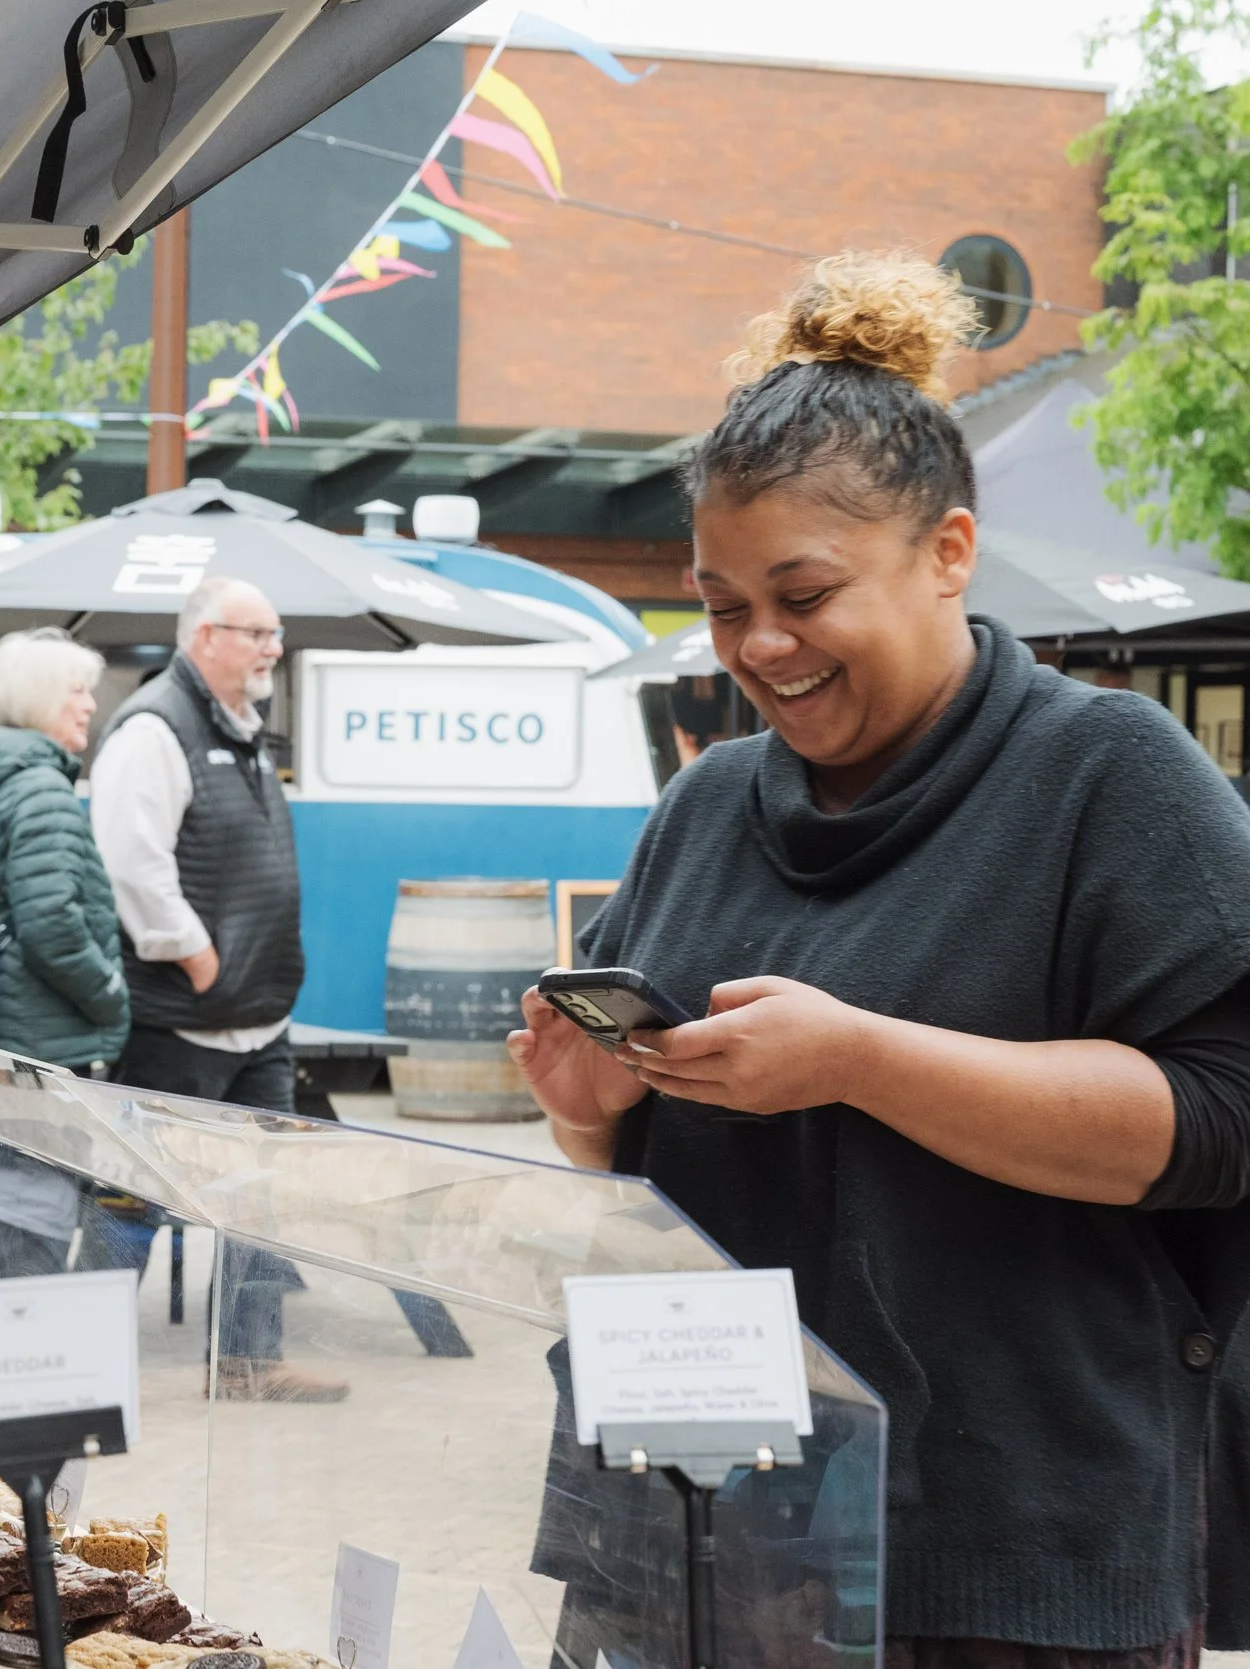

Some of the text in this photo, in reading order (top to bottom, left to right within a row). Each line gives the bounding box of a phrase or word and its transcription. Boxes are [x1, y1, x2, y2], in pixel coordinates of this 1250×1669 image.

[345, 711, 544, 744] PETISCO
[599, 1324, 765, 1346] SPICY CHEDDAR &
[638, 1345, 733, 1366] JALAPEÑO
